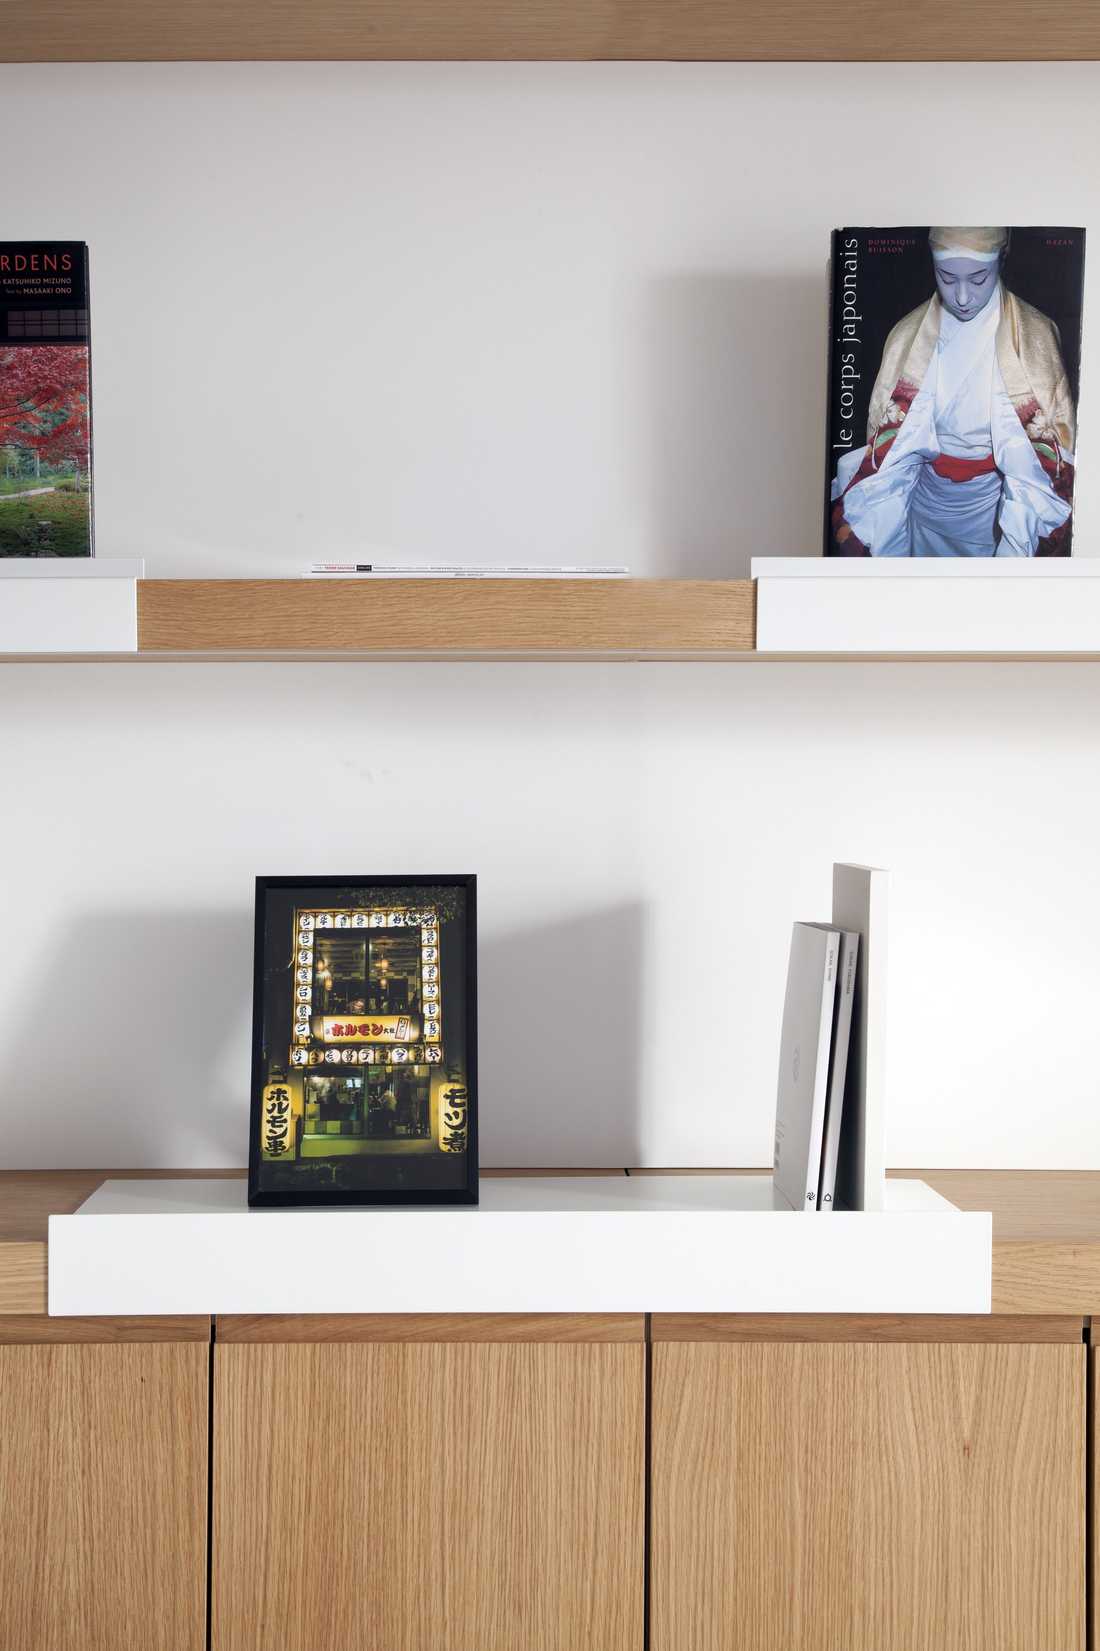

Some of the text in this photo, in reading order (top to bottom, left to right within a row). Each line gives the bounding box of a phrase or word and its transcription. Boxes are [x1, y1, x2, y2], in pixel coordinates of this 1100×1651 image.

[0, 254, 72, 271] RDENS
[2, 277, 72, 285] KATSUHIKO MIZUNO
[833, 238, 862, 448] le corps japonais
[332, 1023, 383, 1036] ホルモン
